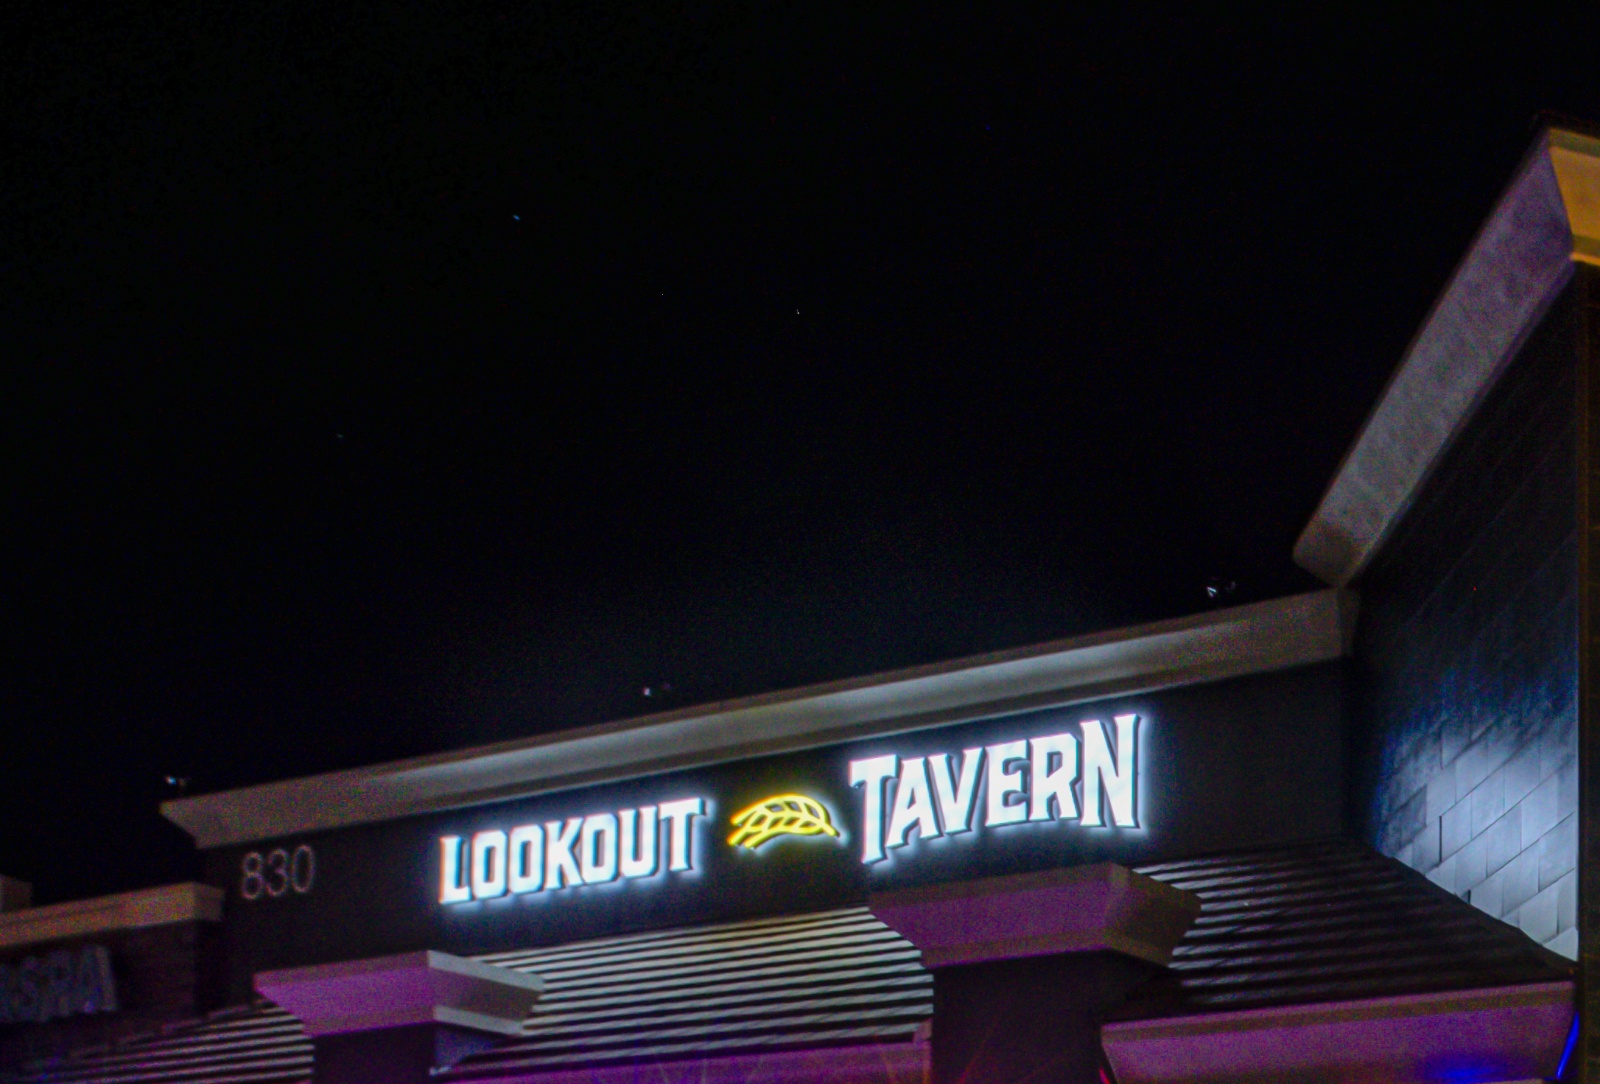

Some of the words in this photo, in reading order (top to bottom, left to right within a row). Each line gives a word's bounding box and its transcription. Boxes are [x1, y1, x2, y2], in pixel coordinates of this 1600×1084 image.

[438, 796, 710, 904] LOOKOUT
[848, 712, 1143, 866] TAVERN
[241, 844, 315, 900] 830
